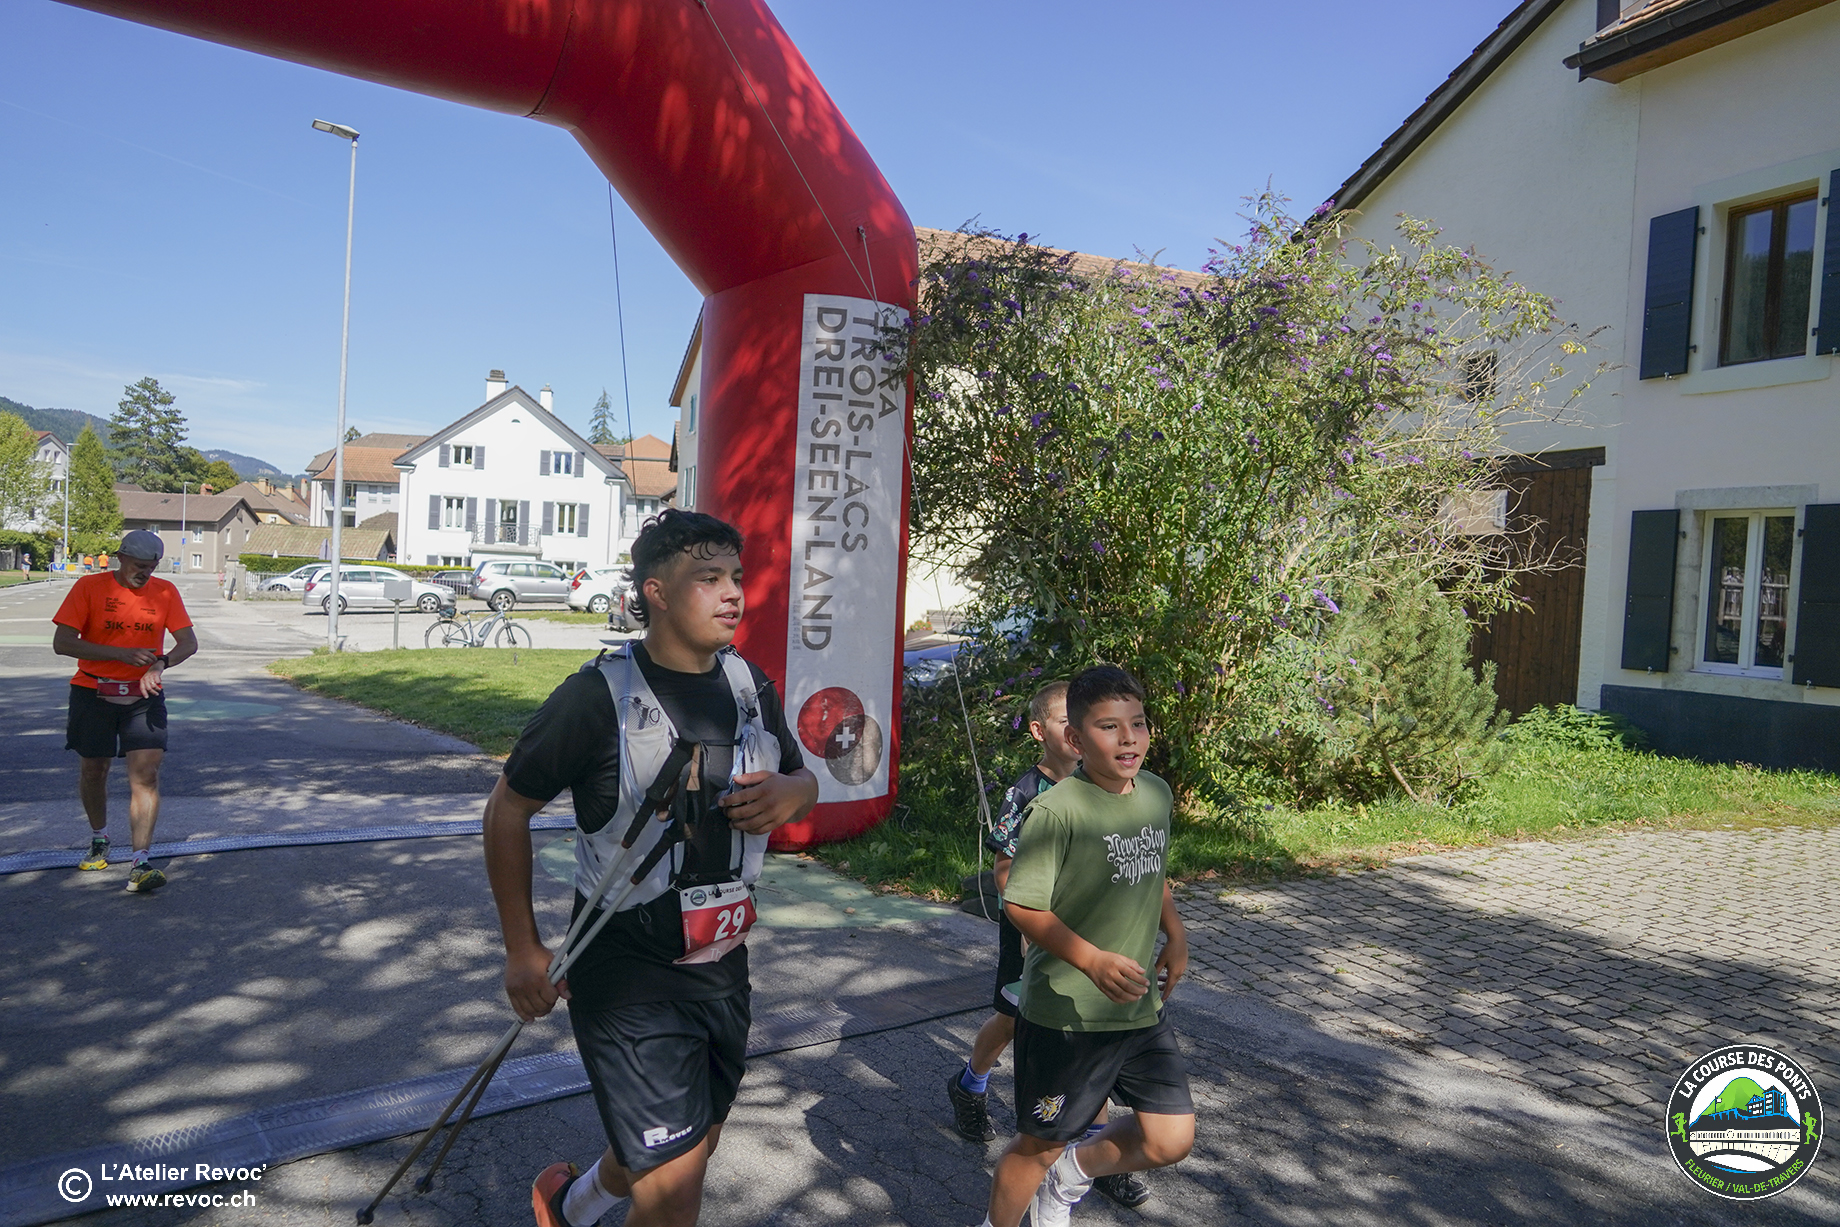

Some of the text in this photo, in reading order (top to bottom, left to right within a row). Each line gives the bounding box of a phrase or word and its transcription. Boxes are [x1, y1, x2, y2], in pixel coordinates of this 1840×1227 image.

[841, 312, 880, 553] TROIS-LACS
[801, 306, 848, 651] DREI-SEEN-LAND
[105, 620, 124, 630] 31K
[134, 622, 153, 632] 51K
[119, 684, 129, 696] 5
[714, 904, 746, 942] 29
